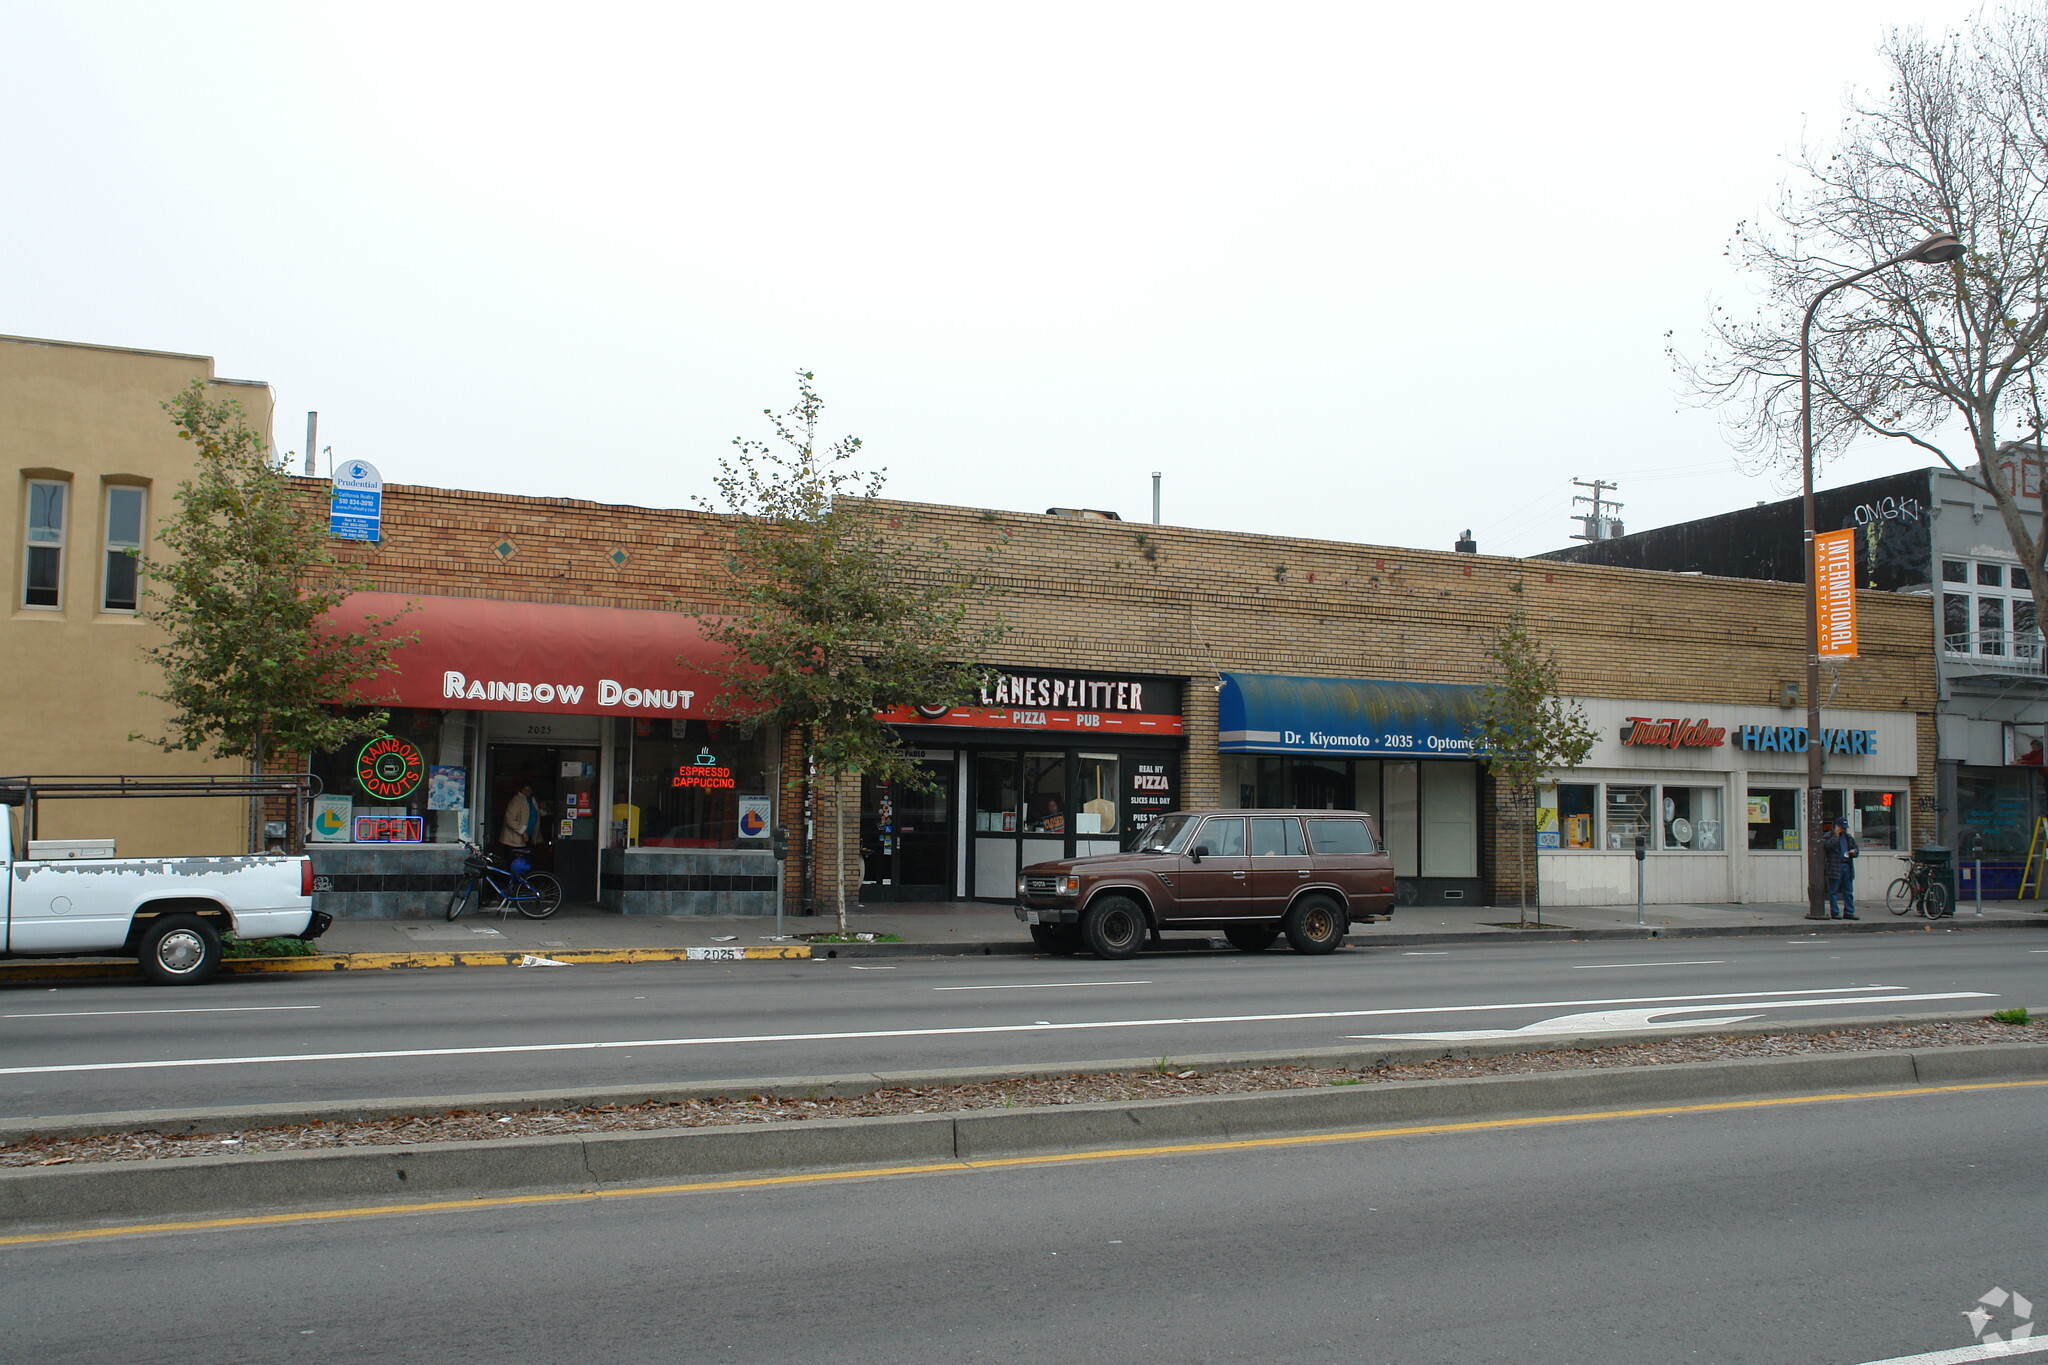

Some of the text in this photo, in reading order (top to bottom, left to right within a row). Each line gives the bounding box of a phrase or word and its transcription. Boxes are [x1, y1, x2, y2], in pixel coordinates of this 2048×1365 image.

[337, 478, 378, 489] Prudential
[1818, 543, 1829, 651] MARKETPLACE
[1828, 539, 1852, 650] INTERNATIONAL
[443, 670, 695, 710] RAINBOW DONUT
[980, 673, 1143, 712] LANESPLITTER
[1012, 711, 1101, 727] PIZZA PUB
[527, 725, 552, 734] 2025
[1284, 731, 1305, 744] Dr.
[1310, 731, 1370, 749] Kiyomoto
[1384, 734, 1413, 748] 2035
[1741, 725, 1878, 755] HARDWARE
[361, 739, 421, 766] RAINBOW
[679, 766, 730, 778] ESPRESSO
[1138, 765, 1164, 773] REAL NY
[360, 769, 420, 796] DONUTS
[672, 777, 735, 789] CAPPUCCINO
[1133, 775, 1169, 790] PIZZA
[1130, 796, 1148, 804] SLICES
[1159, 797, 1171, 805] DAY
[1132, 813, 1148, 821] PIES
[356, 819, 421, 841] OPEN
[703, 949, 735, 960] 2025
